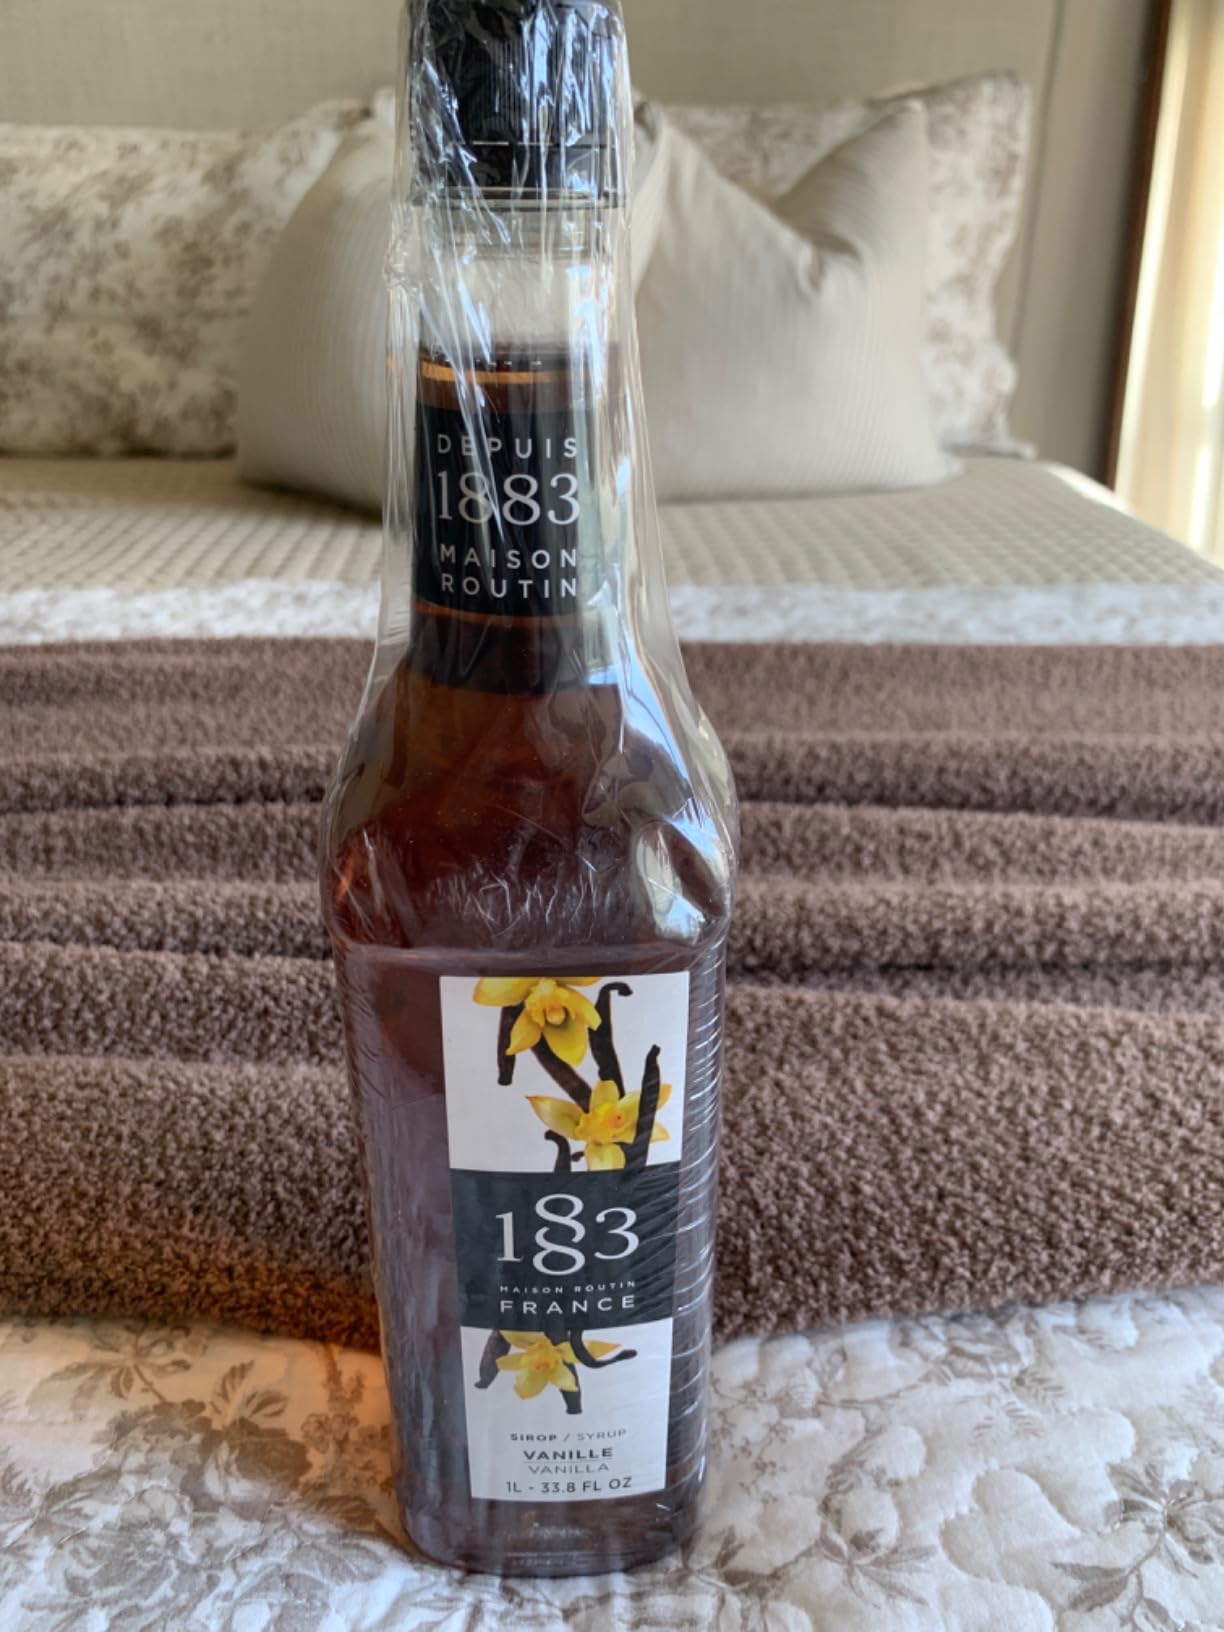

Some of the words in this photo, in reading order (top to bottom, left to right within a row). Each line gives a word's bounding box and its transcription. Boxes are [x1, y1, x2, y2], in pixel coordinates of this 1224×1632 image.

[437, 434, 577, 459] DEPUIS
[437, 471, 580, 526] 1883
[440, 544, 576, 569] MAISON
[441, 573, 577, 598] ROUTIN
[500, 1285, 563, 1294] MAISON
[574, 1280, 636, 1293] ROUTIN
[501, 1295, 635, 1315] FRANCE
[510, 1433, 557, 1442] SIROP
[577, 1428, 627, 1442] SYRUP
[523, 1448, 613, 1461] VANILLE
[528, 1462, 610, 1475] VANILLA
[506, 1481, 522, 1494] 1L
[541, 1480, 576, 1494] 33.8
[582, 1479, 602, 1492] FL
[608, 1477, 632, 1490] OZ
